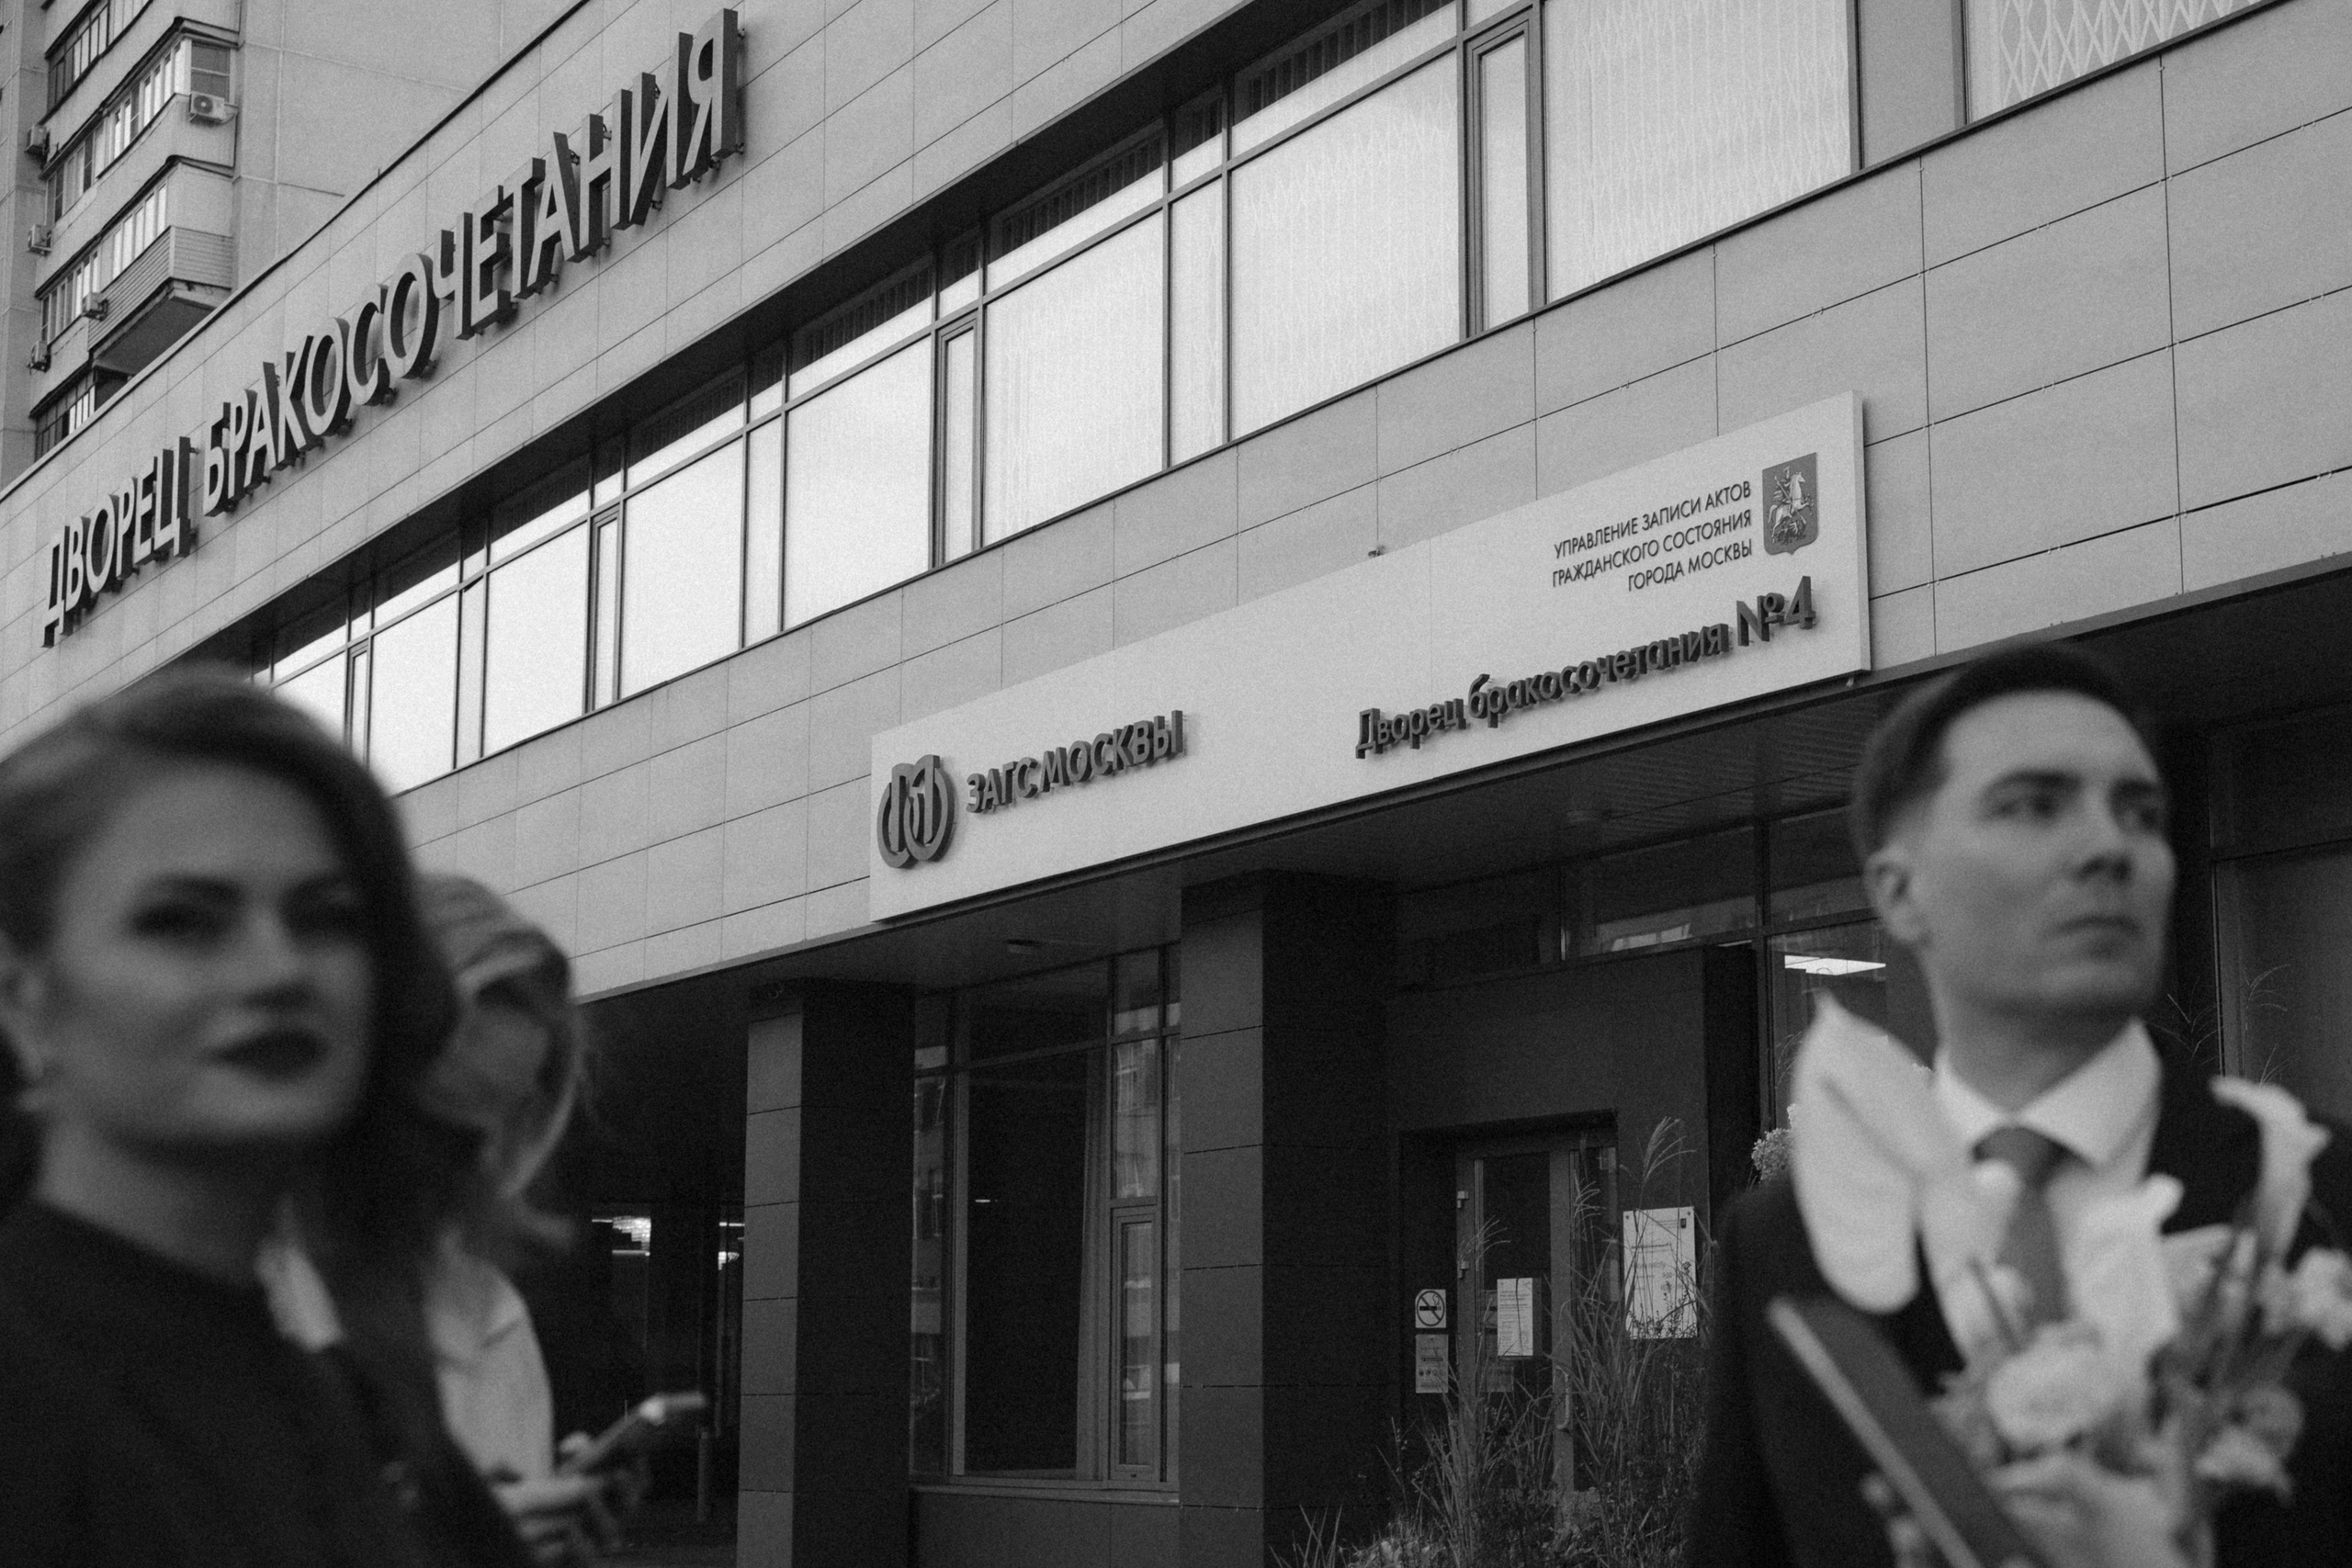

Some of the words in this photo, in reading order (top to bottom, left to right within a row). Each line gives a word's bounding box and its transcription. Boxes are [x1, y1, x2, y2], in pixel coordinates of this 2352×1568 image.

[41, 436, 191, 648] ДВОРЕЦ
[203, 8, 739, 516] БРАКОСОЧЕТАНИЯ
[1553, 540, 1659, 588] ГРАЖДАНСКОГО
[1662, 510, 1752, 552] СОСТОЯНИЯ
[1554, 517, 1638, 558] УПРАВЛЕНИЕ
[1642, 497, 1702, 531] ЗАПИСИ
[1704, 480, 1751, 511] АКТОВ
[1628, 563, 1685, 592] ГОРОДА
[1688, 538, 1752, 575] МОСКВЫ
[1355, 698, 1465, 759] Дворец
[1468, 624, 1731, 728] бракосочетания
[1736, 575, 1816, 647] №4
[966, 757, 1038, 813] ЗАГС
[1038, 710, 1183, 793] МОСКВЫ
